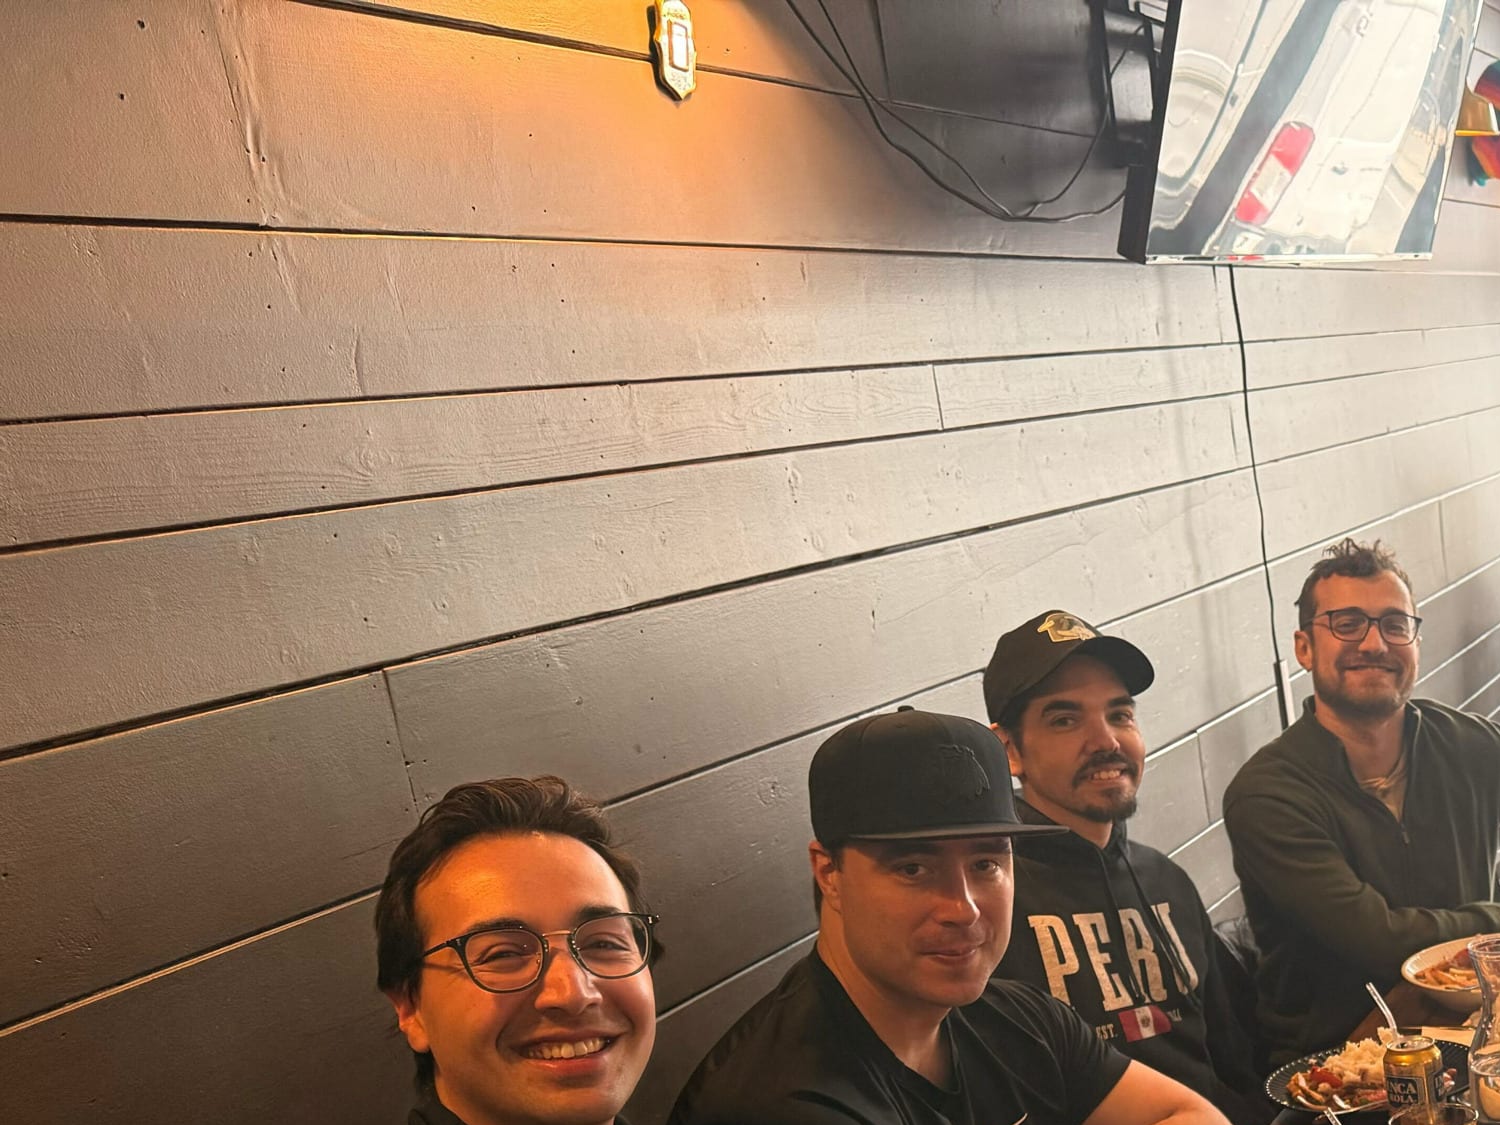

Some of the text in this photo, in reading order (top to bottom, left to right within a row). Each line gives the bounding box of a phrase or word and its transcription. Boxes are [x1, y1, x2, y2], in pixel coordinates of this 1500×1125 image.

[1027, 902, 1199, 1012] PERU
[1387, 1080, 1416, 1094] NCA
[1390, 1095, 1414, 1104] OLA
